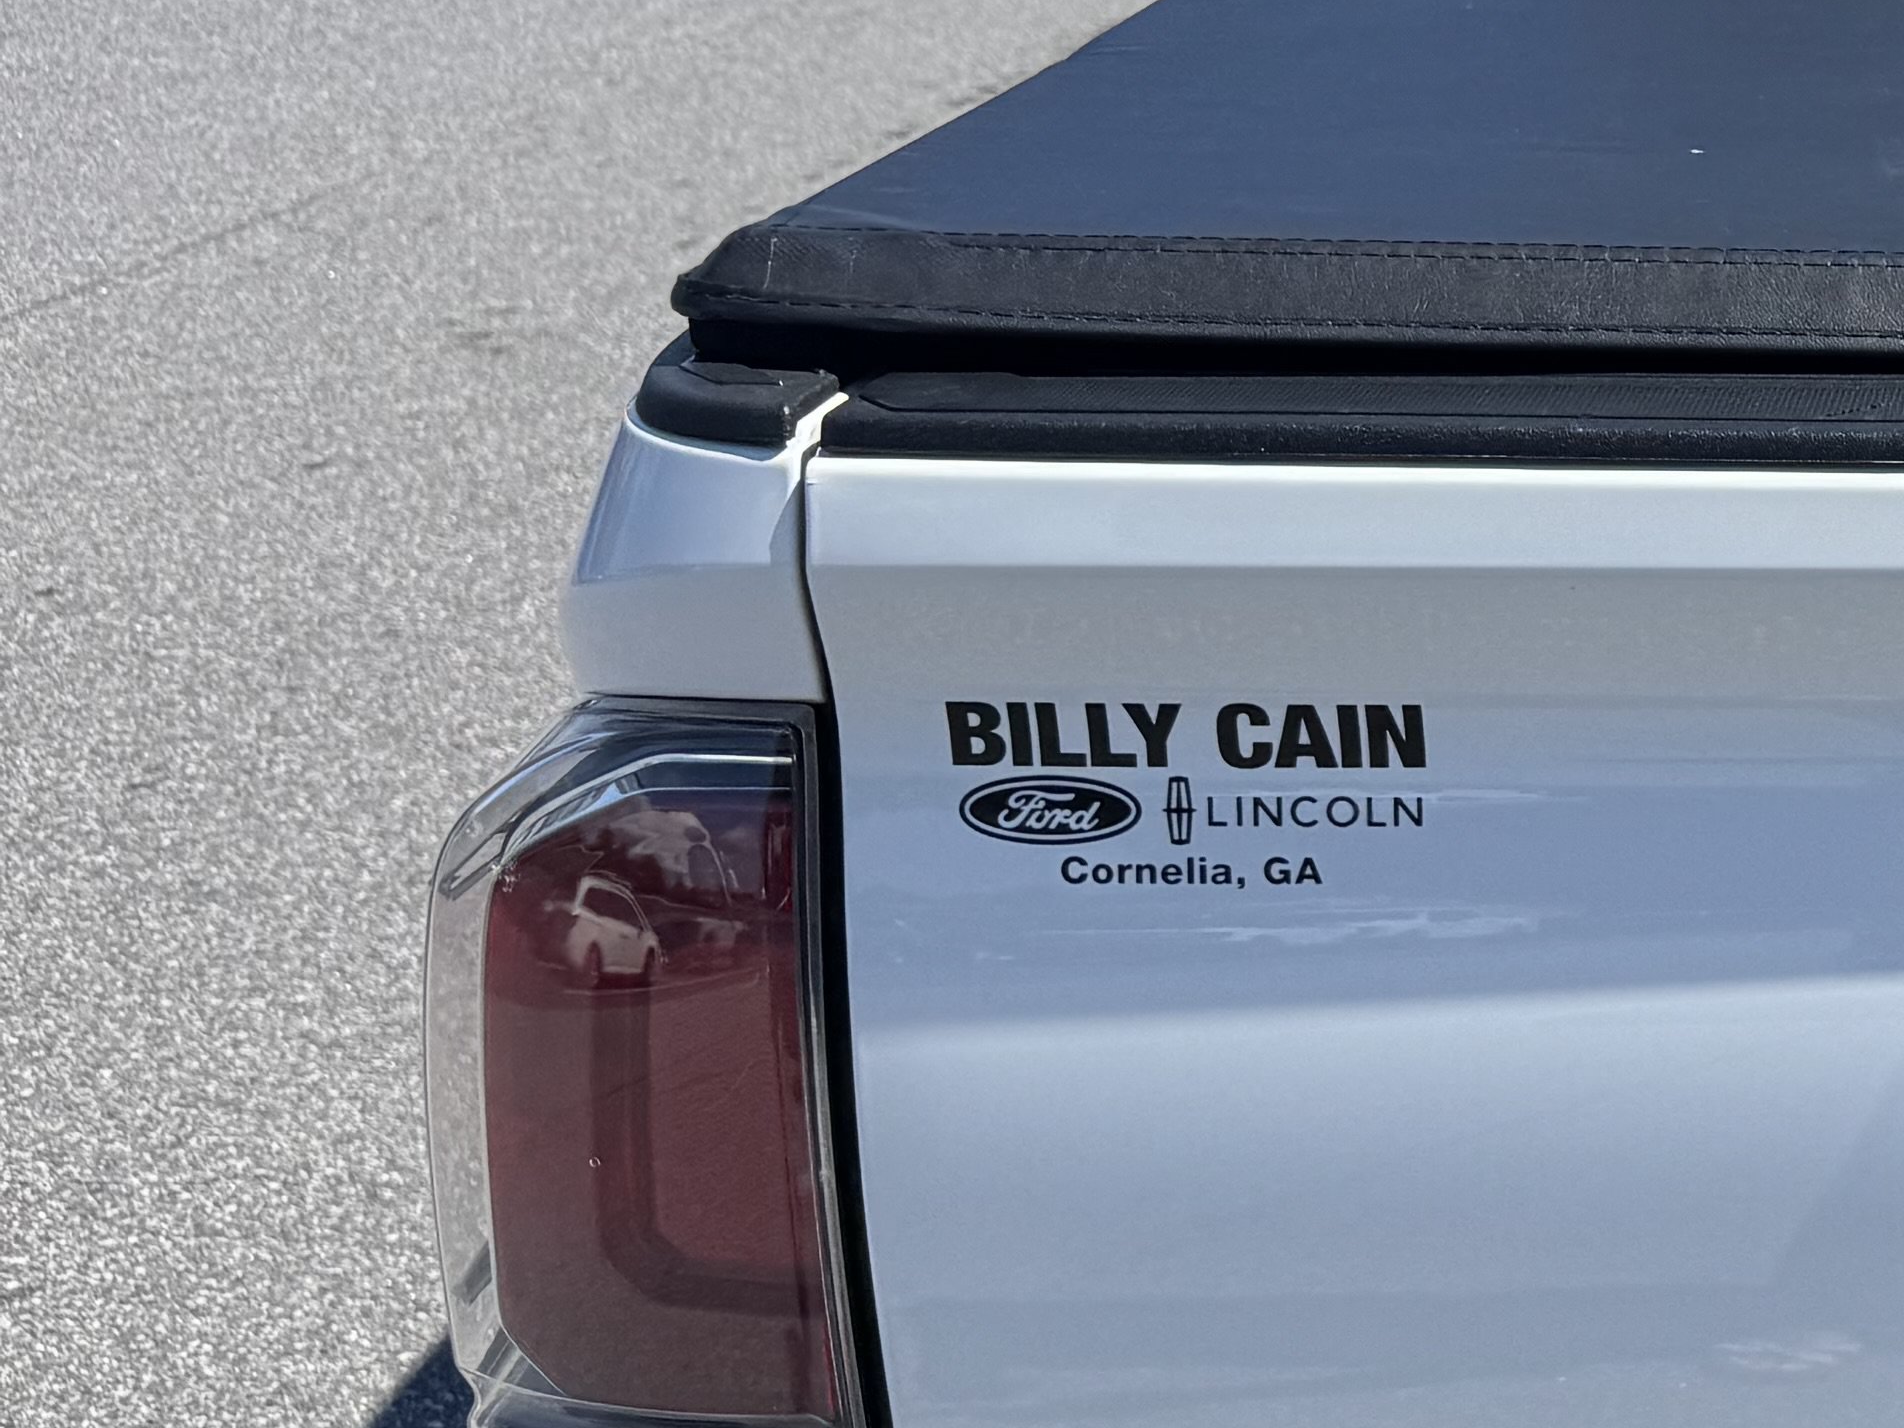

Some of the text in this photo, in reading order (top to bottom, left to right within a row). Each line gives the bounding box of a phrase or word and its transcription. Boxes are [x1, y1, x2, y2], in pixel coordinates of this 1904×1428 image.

[944, 700, 1427, 770] BILLY CAIN
[1206, 795, 1424, 828] LINCOLN
[1060, 855, 1324, 890] Cornelia, GA
